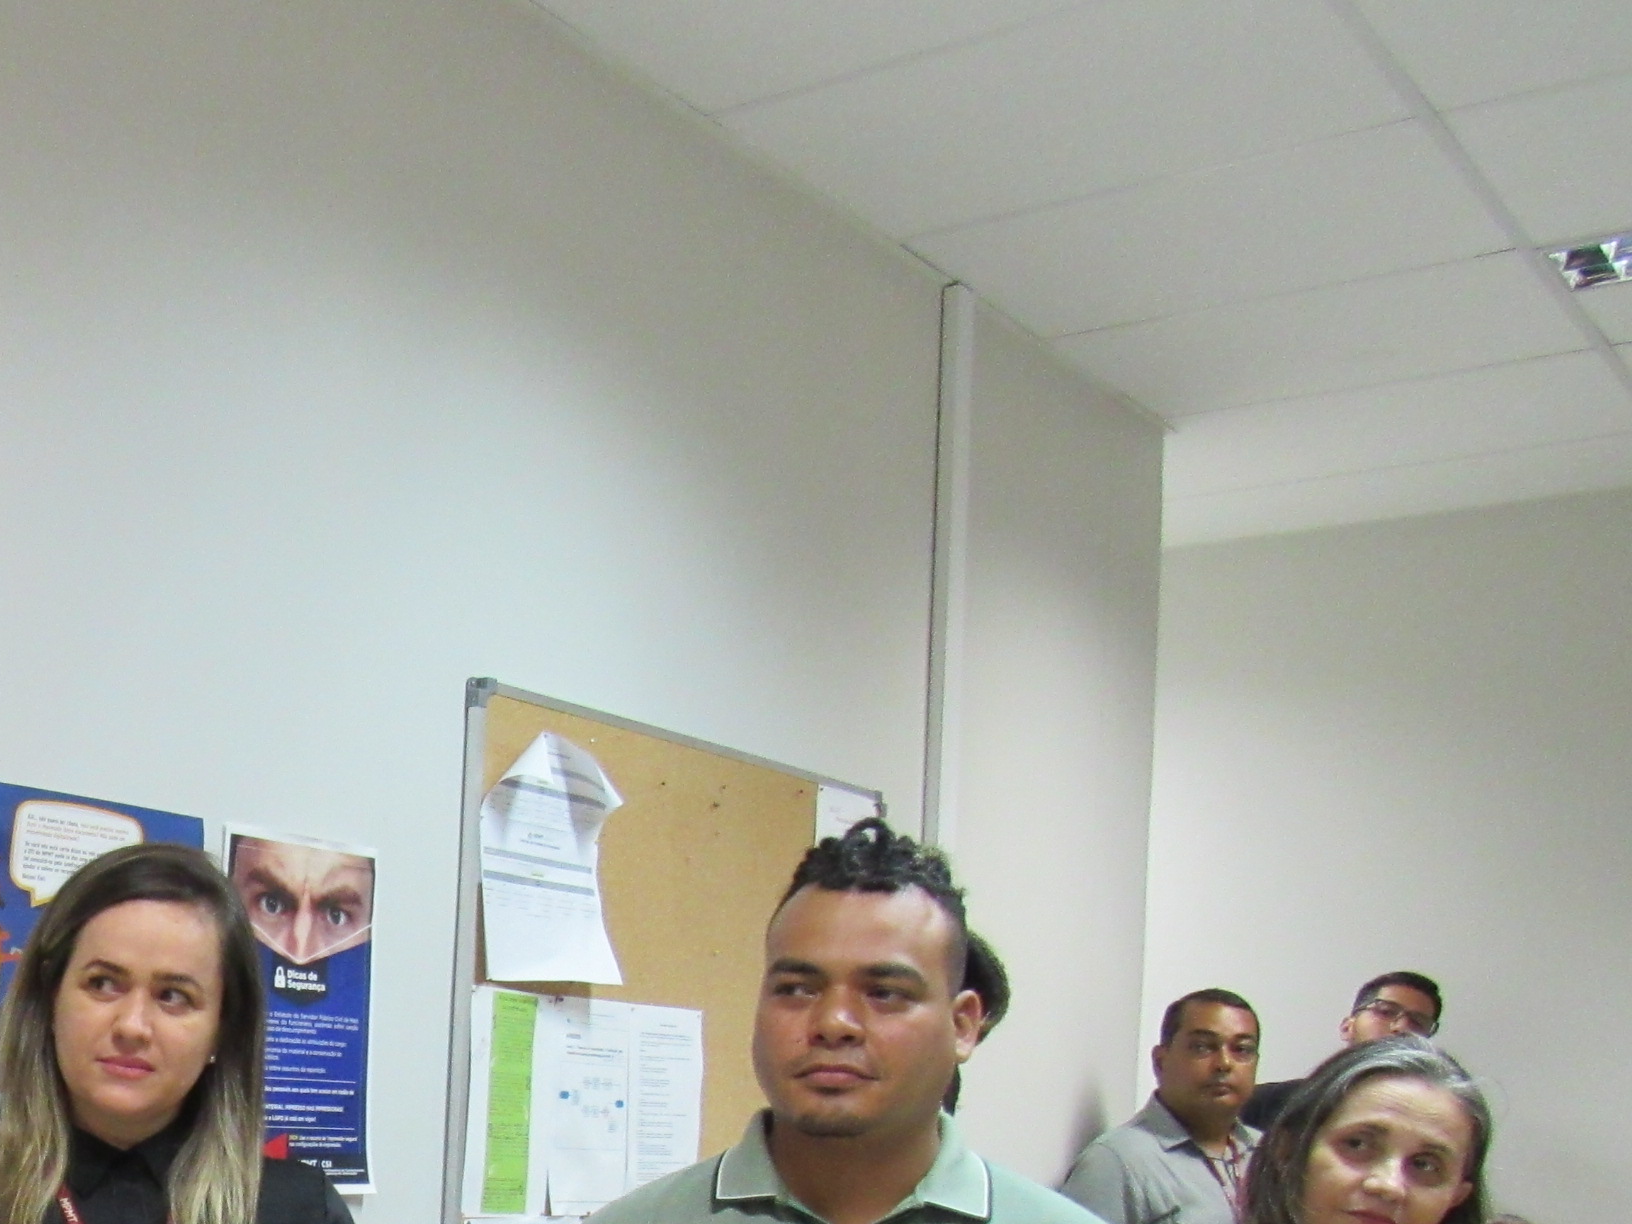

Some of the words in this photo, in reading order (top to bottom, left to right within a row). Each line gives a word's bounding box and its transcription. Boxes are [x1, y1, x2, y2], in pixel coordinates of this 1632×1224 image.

[287, 969, 307, 980] Dicas
[307, 971, 318, 981] de
[287, 980, 326, 992] Segurança
[321, 1160, 332, 1168] CSI
[59, 1197, 79, 1223] MPMT
